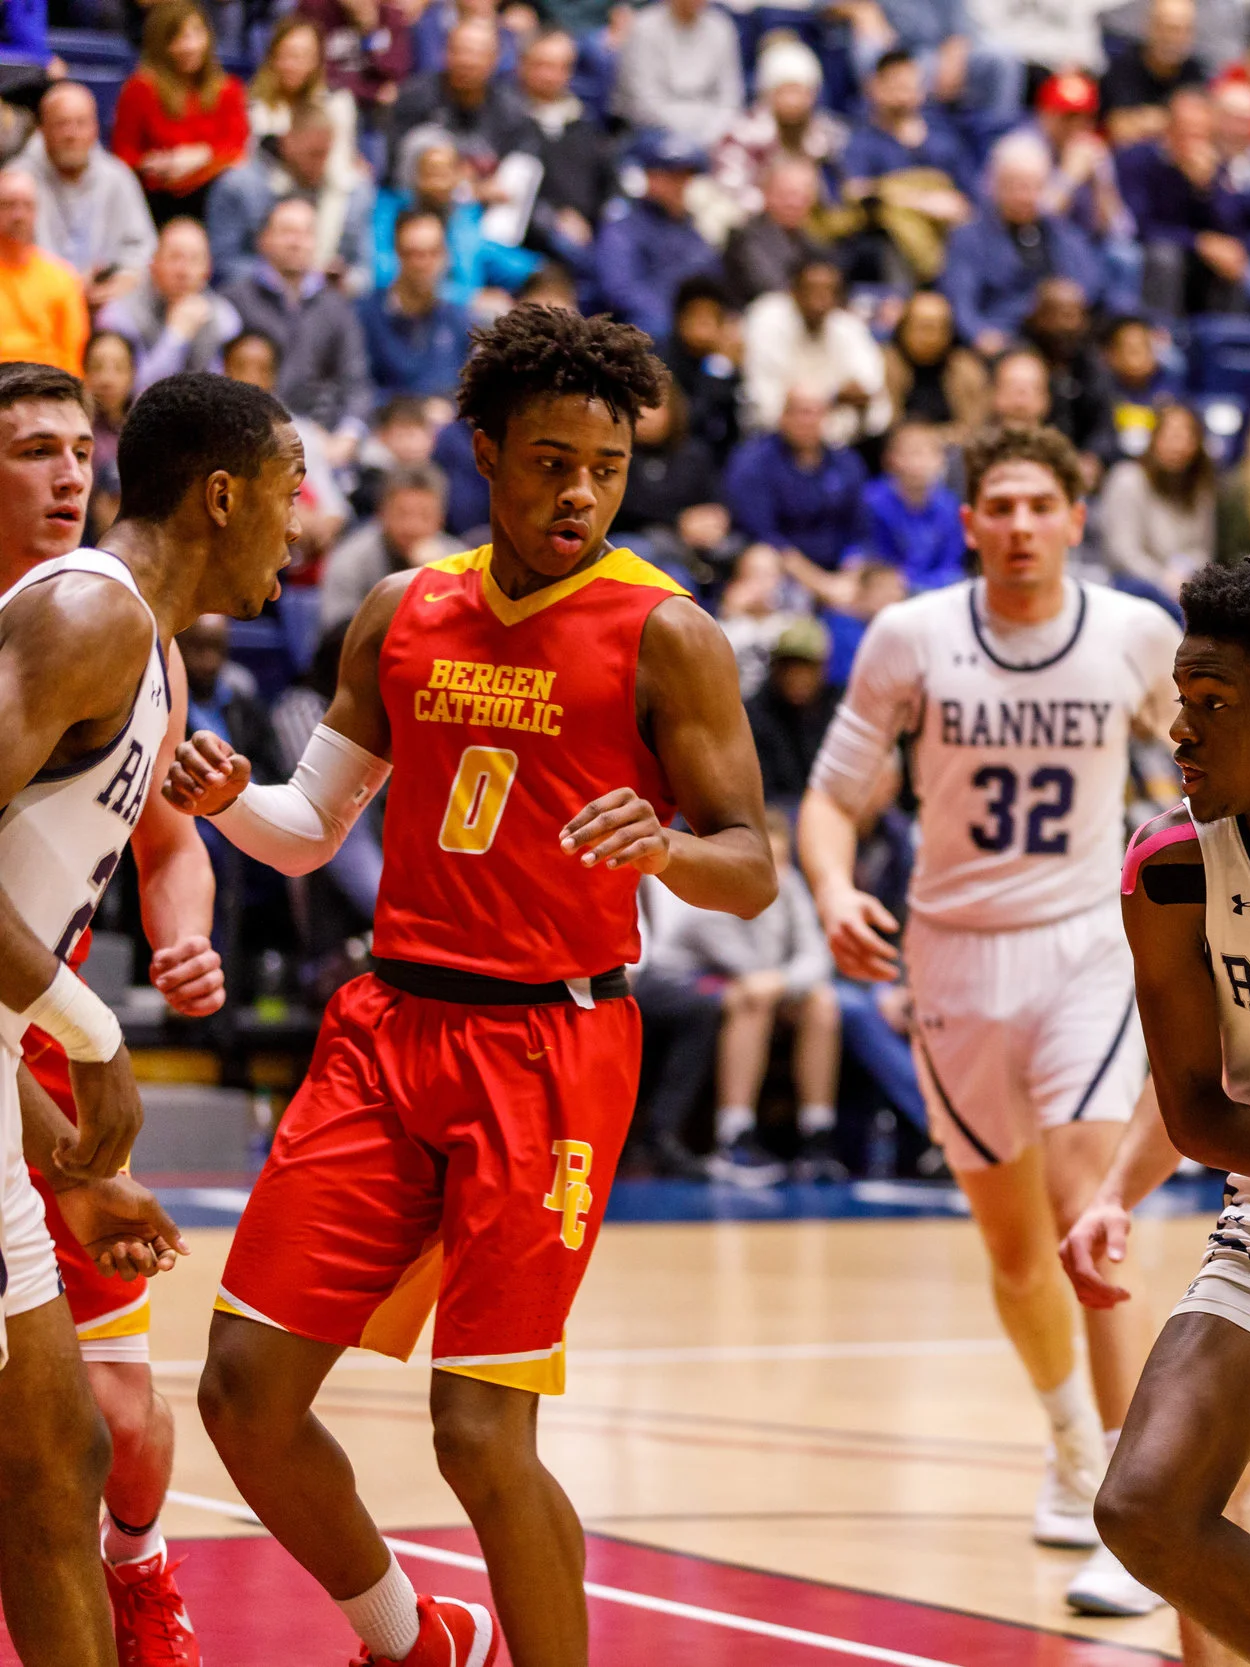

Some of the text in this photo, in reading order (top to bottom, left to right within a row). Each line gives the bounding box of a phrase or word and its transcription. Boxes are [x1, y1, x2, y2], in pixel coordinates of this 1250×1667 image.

[427, 659, 557, 701] BERGEN
[414, 690, 564, 736] CATHOLIC
[941, 699, 1113, 748] RANNEY
[438, 745, 519, 855] 0
[970, 763, 1075, 855] 32
